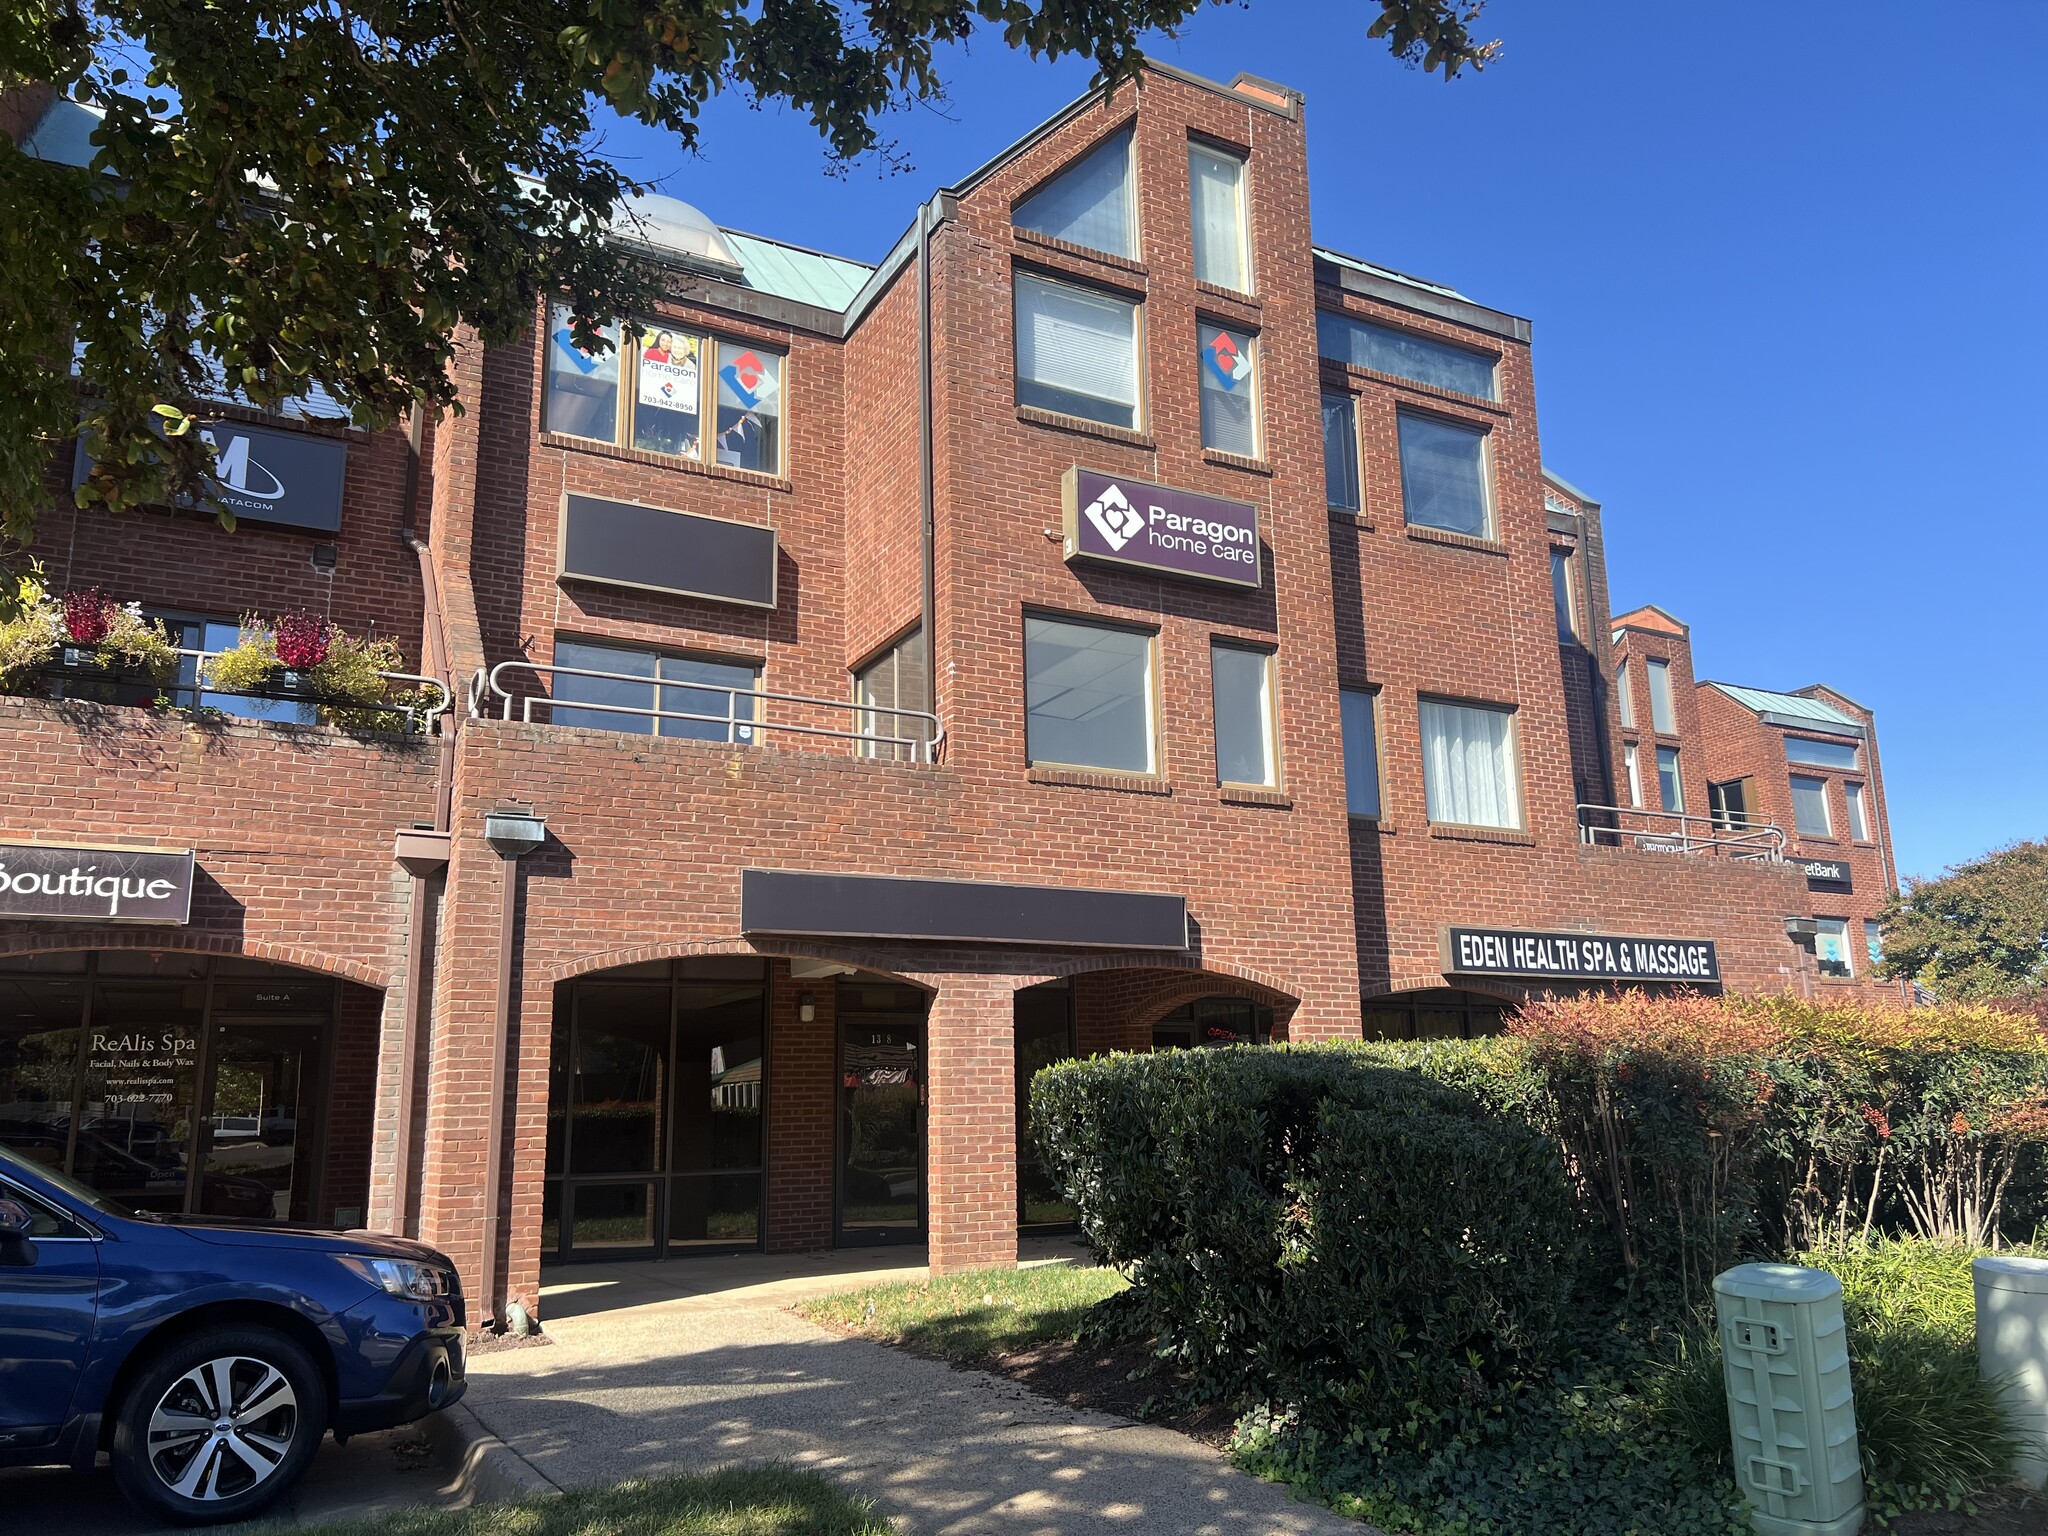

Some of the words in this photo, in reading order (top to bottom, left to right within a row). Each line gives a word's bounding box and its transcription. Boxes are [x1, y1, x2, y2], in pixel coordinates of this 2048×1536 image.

[642, 358, 696, 378] Paragon
[642, 369, 670, 380] home
[673, 375, 697, 386] care
[643, 395, 693, 411] 703-942-8950
[217, 496, 273, 511] ATACOM
[1148, 505, 1254, 545] Paragon
[1148, 527, 1207, 555] home
[1212, 543, 1255, 565] care
[1459, 934, 1509, 968] EDEN
[1511, 937, 1580, 971] HEALTH
[1582, 940, 1617, 972] SPA
[1619, 943, 1633, 973] &
[1634, 943, 1710, 976] MASSAGE
[256, 993, 280, 1001] Suite
[1207, 1027, 1237, 1041] OPEN
[91, 1034, 155, 1052] ReAlis
[160, 1033, 197, 1057] Spa
[89, 1059, 117, 1069] Facial,
[118, 1059, 140, 1068] Nails
[141, 1060, 151, 1068] &
[152, 1059, 174, 1069] Body
[175, 1058, 194, 1067] Wax
[106, 1077, 174, 1087] www.realisspa.com
[104, 1093, 173, 1104] 703-622-7770
[150, 1170, 176, 1179] Open
